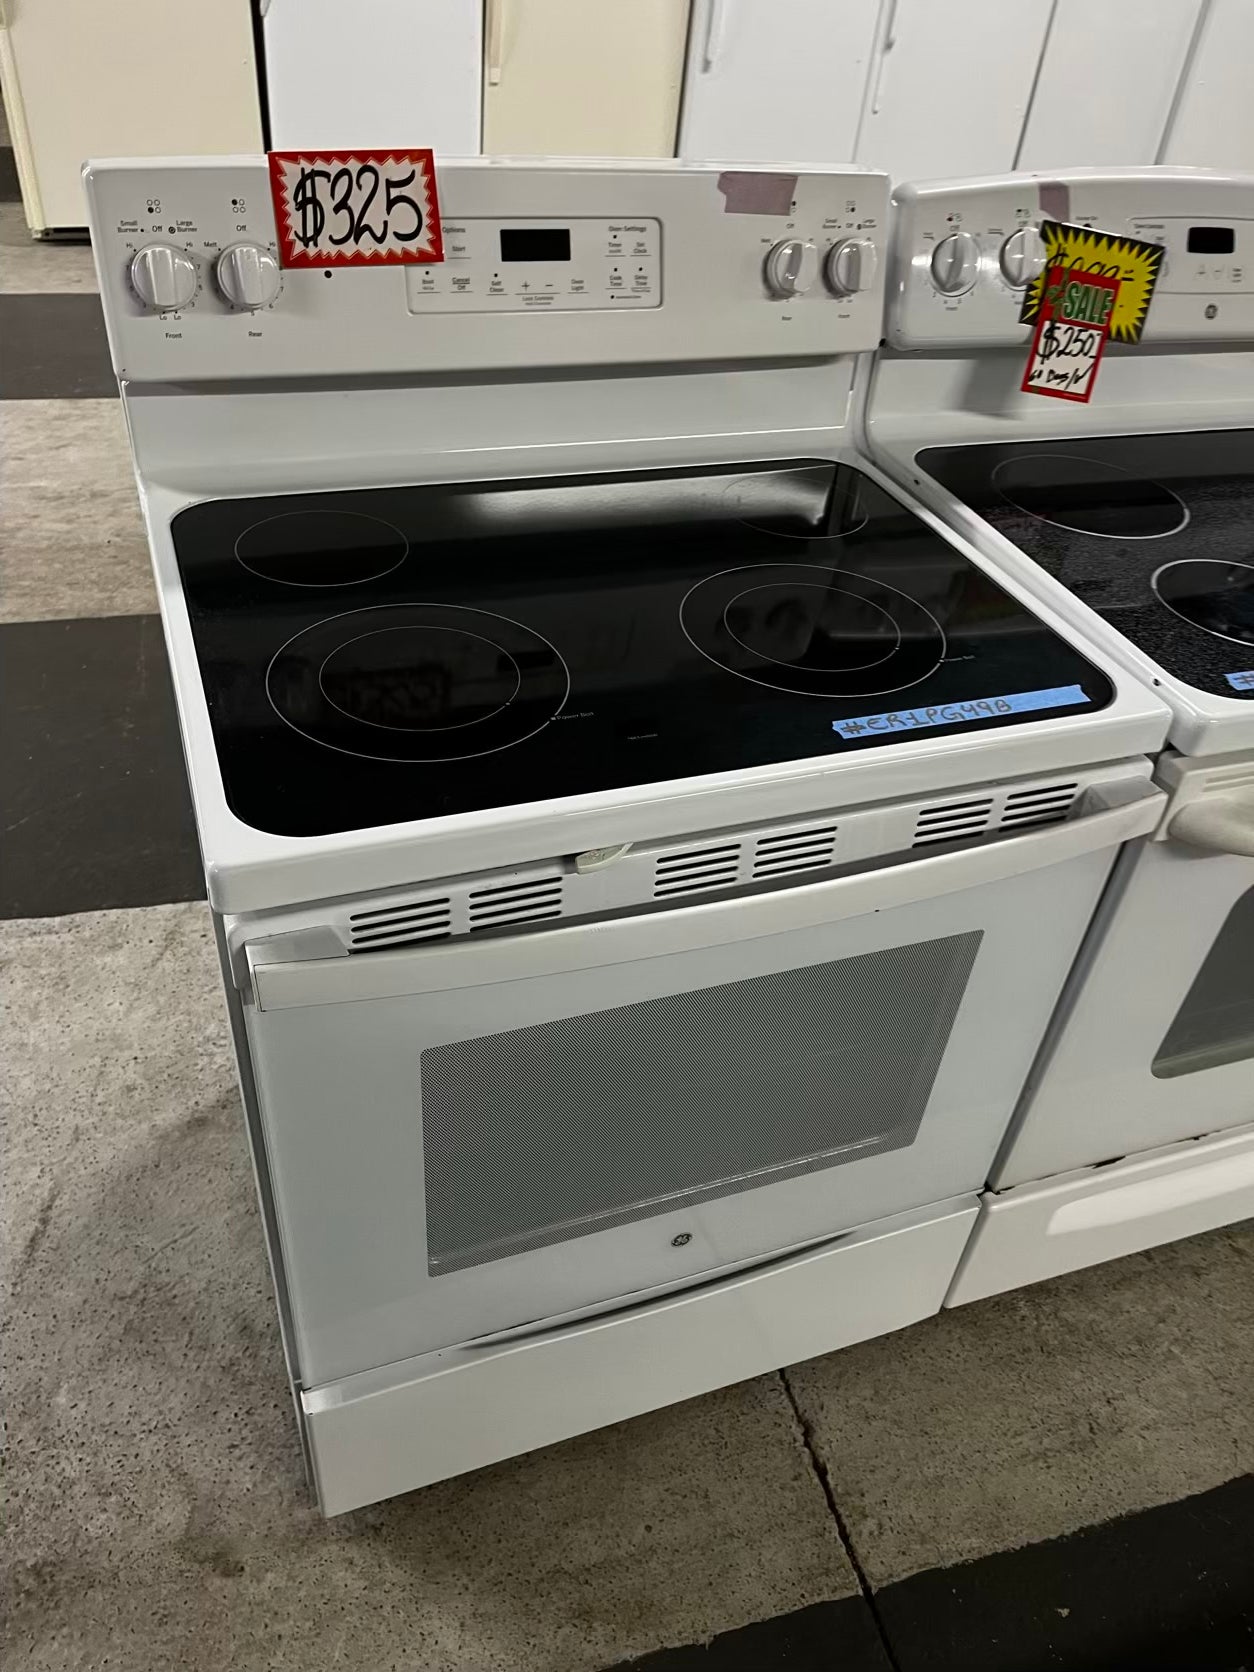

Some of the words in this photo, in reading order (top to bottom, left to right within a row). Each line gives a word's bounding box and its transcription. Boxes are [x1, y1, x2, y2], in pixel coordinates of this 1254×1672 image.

[293, 164, 423, 248] $325
[152, 225, 162, 233] Off
[236, 224, 247, 232] Off
[1062, 280, 1115, 327] SALE
